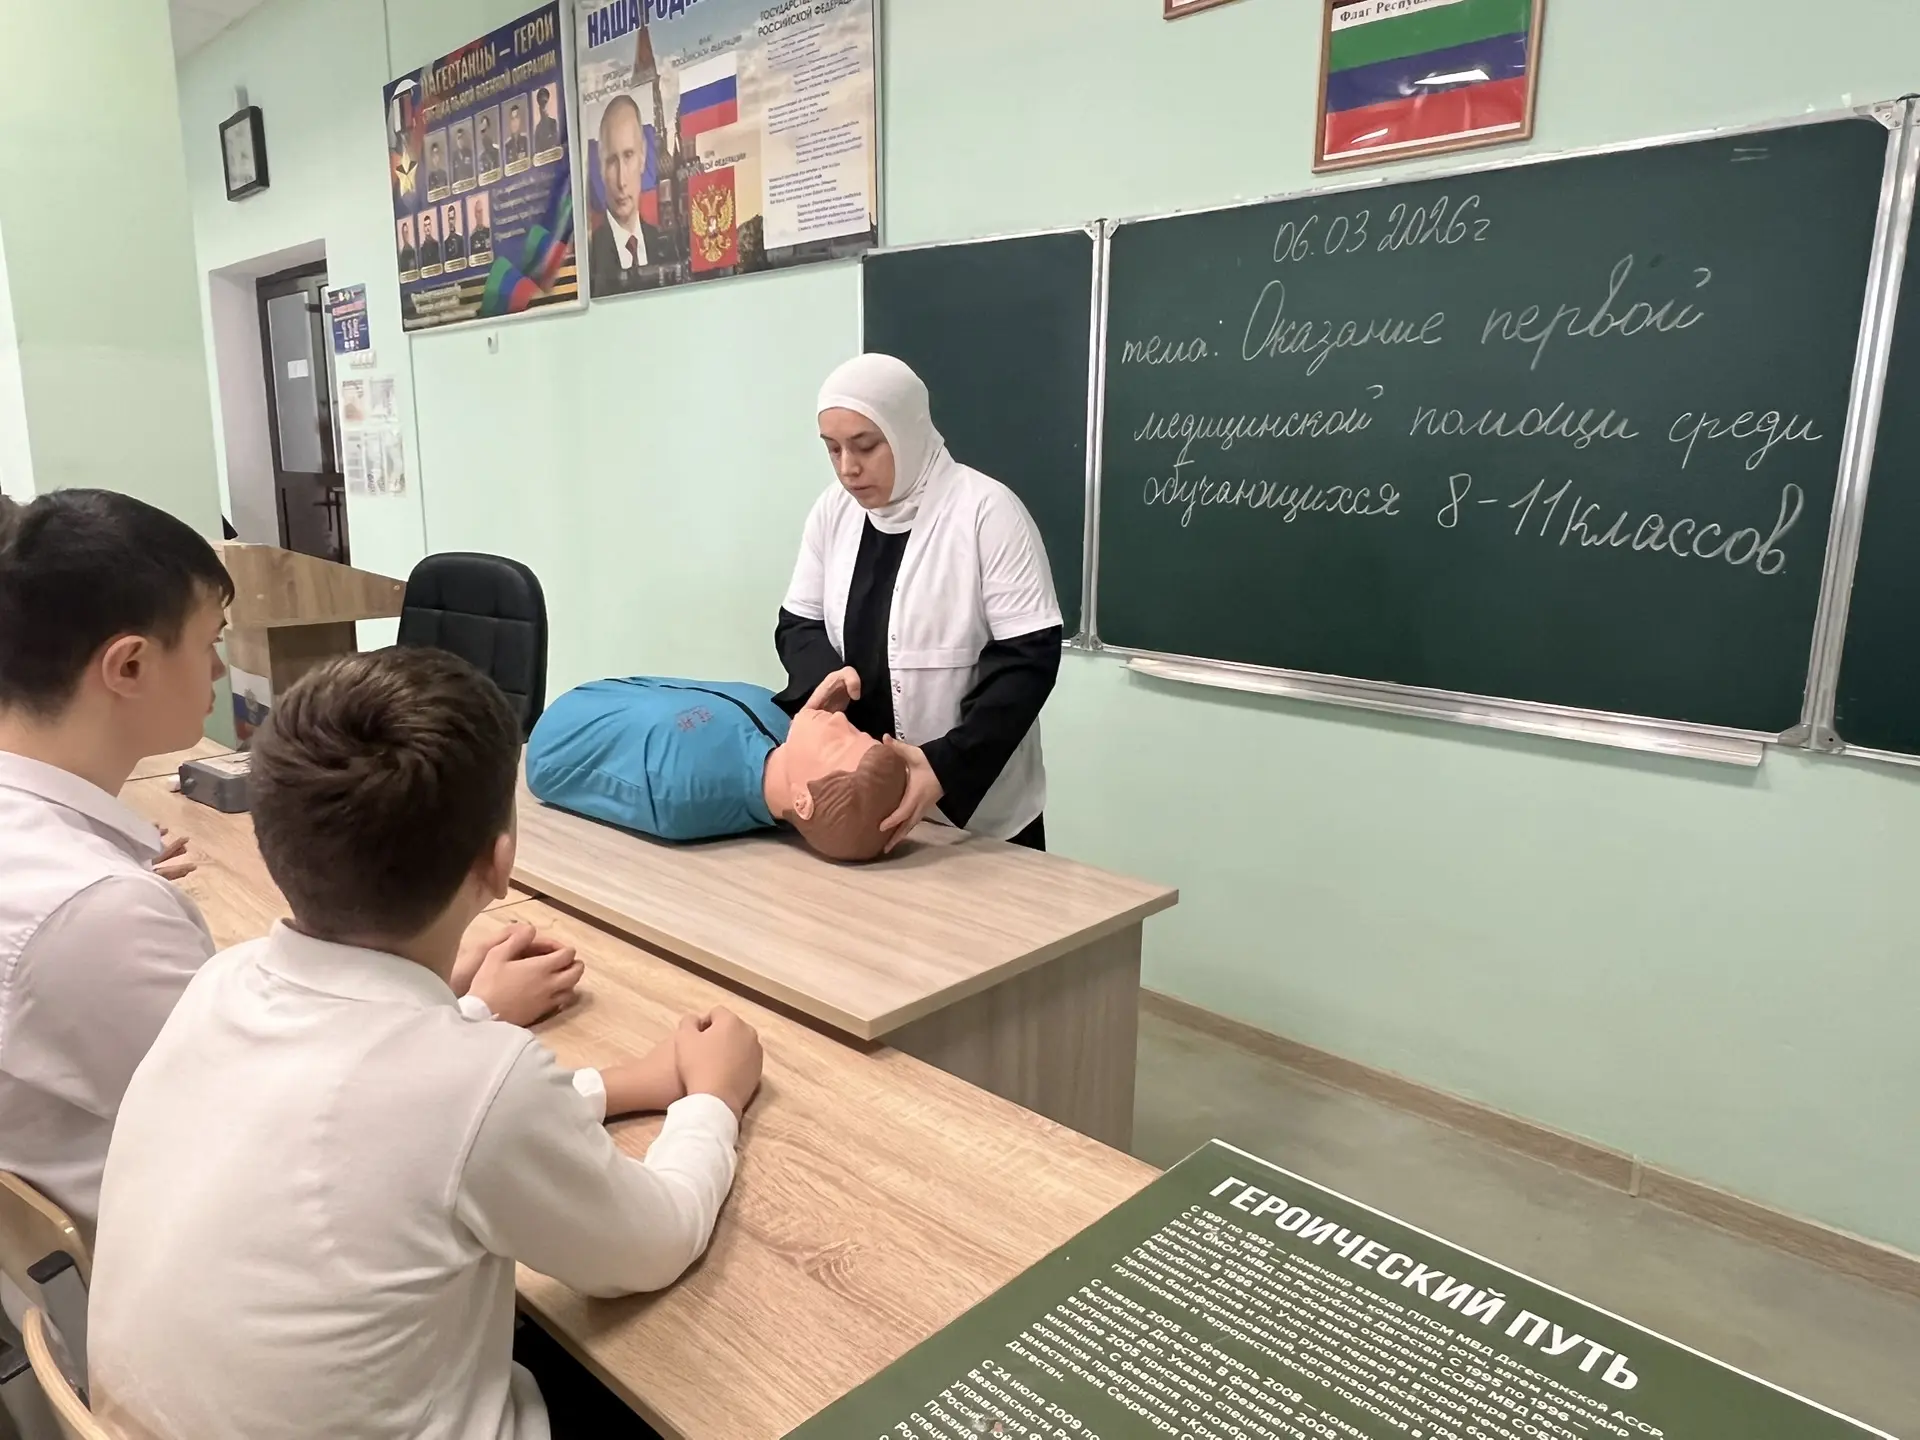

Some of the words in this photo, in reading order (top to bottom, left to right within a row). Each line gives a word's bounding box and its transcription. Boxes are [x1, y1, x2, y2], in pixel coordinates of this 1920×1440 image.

[513, 11, 555, 58] ГЕРОИ
[587, 0, 641, 49] НАША
[1340, 7, 1371, 22] Флаг
[1242, 280, 1445, 377] Оказание
[1481, 253, 1712, 371] первой
[1134, 384, 1385, 465] медицинской
[1409, 402, 1640, 450] помощи
[1668, 411, 1824, 472] среди
[1144, 460, 1401, 528] обучающихся
[1142, 1239, 1212, 1279] Республике
[1210, 1277, 1273, 1313] Дагестан.
[1275, 1309, 1340, 1347] Участник
[1341, 1345, 1396, 1377] первой
[1411, 1381, 1468, 1415] второй
[1150, 1233, 1207, 1265] Дагестан.
[1223, 1268, 1253, 1287] 1996
[1253, 1285, 1316, 1320] назначен
[1316, 1318, 1418, 1374] заместителем
[1419, 1371, 1507, 1420] командира
[1161, 1226, 1224, 1260] начальник
[1225, 1258, 1358, 1328] оперативно-боевого
[1360, 1327, 1437, 1369] отделения
[1440, 1366, 1486, 1391] СОБР
[1487, 1390, 1529, 1417] МВД
[1202, 1210, 1228, 1226] 1991
[1227, 1223, 1243, 1234] по
[1245, 1231, 1275, 1248] 1992
[1288, 1253, 1353, 1287] командир
[1354, 1285, 1404, 1313] взвода
[1406, 1309, 1454, 1337] ППСМ
[1455, 1333, 1494, 1357] МВД
[1493, 1353, 1608, 1412] Дагестанской
[1208, 1176, 1506, 1325] ГЕРОИЧЕСКИЙ
[1504, 1309, 1638, 1390] ПУТЬ
[1220, 1231, 1236, 1242] по
[1238, 1239, 1269, 1257] 1995
[1282, 1262, 1364, 1306] заместитель
[1366, 1303, 1446, 1346] командира
[1446, 1344, 1489, 1369] роты,
[1493, 1367, 1541, 1393] затем
[1544, 1391, 1629, 1437] командир
[1005, 1340, 1064, 1382] Дагестан.
[1019, 1331, 1106, 1388] заместителем
[1107, 1386, 1179, 1436] Секретаря
[1032, 1322, 1091, 1362] охранном
[1091, 1359, 1179, 1417] предприятии
[1043, 1313, 1105, 1355] милиции».
[1120, 1360, 1181, 1400] февраля
[1181, 1398, 1201, 1412] по
[1056, 1304, 1105, 1336] октябре
[1105, 1333, 1141, 1357] 2005
[1140, 1355, 1213, 1402] присвоено
[1067, 1295, 1138, 1340] внутренних
[1136, 1338, 1164, 1357] дел.
[1166, 1353, 1218, 1387] Указом
[1078, 1286, 1149, 1331] Республике
[1148, 1328, 1212, 1369] Дагестан.
[1228, 1375, 1293, 1415] феврале
[1100, 1285, 1146, 1313] января
[1145, 1310, 1182, 1333] 2005
[1180, 1331, 1199, 1343] по
[1199, 1342, 1260, 1380] февраль
[1262, 1376, 1303, 1403] 2008
[1111, 1263, 1189, 1308] группировок
[1201, 1312, 1331, 1387] террористического
[1333, 1385, 1409, 1431] подполья
[1121, 1255, 1164, 1280] против
[1165, 1278, 1296, 1355] бандформирований,
[1299, 1352, 1425, 1424] организованных
[1132, 1247, 1193, 1283] Принимал
[1192, 1280, 1244, 1310] участие
[1255, 1314, 1298, 1339] лично
[1297, 1337, 1378, 1382] руководил
[1378, 1380, 1463, 1428] десятками
[1242, 1253, 1275, 1274] МВД
[1274, 1270, 1292, 1282] по
[1293, 1279, 1373, 1323] Республике
[1373, 1320, 1444, 1360] Дагестан.
[1465, 1364, 1503, 1387] 1995
[1504, 1385, 1525, 1399] по
[1530, 1397, 1569, 1421] 1996
[950, 1379, 1028, 1435] управления
[967, 1368, 1053, 1432] Безопасности
[991, 1366, 1011, 1381] 24
[1009, 1379, 1045, 1406] июля
[1045, 1402, 1082, 1430] 2009
